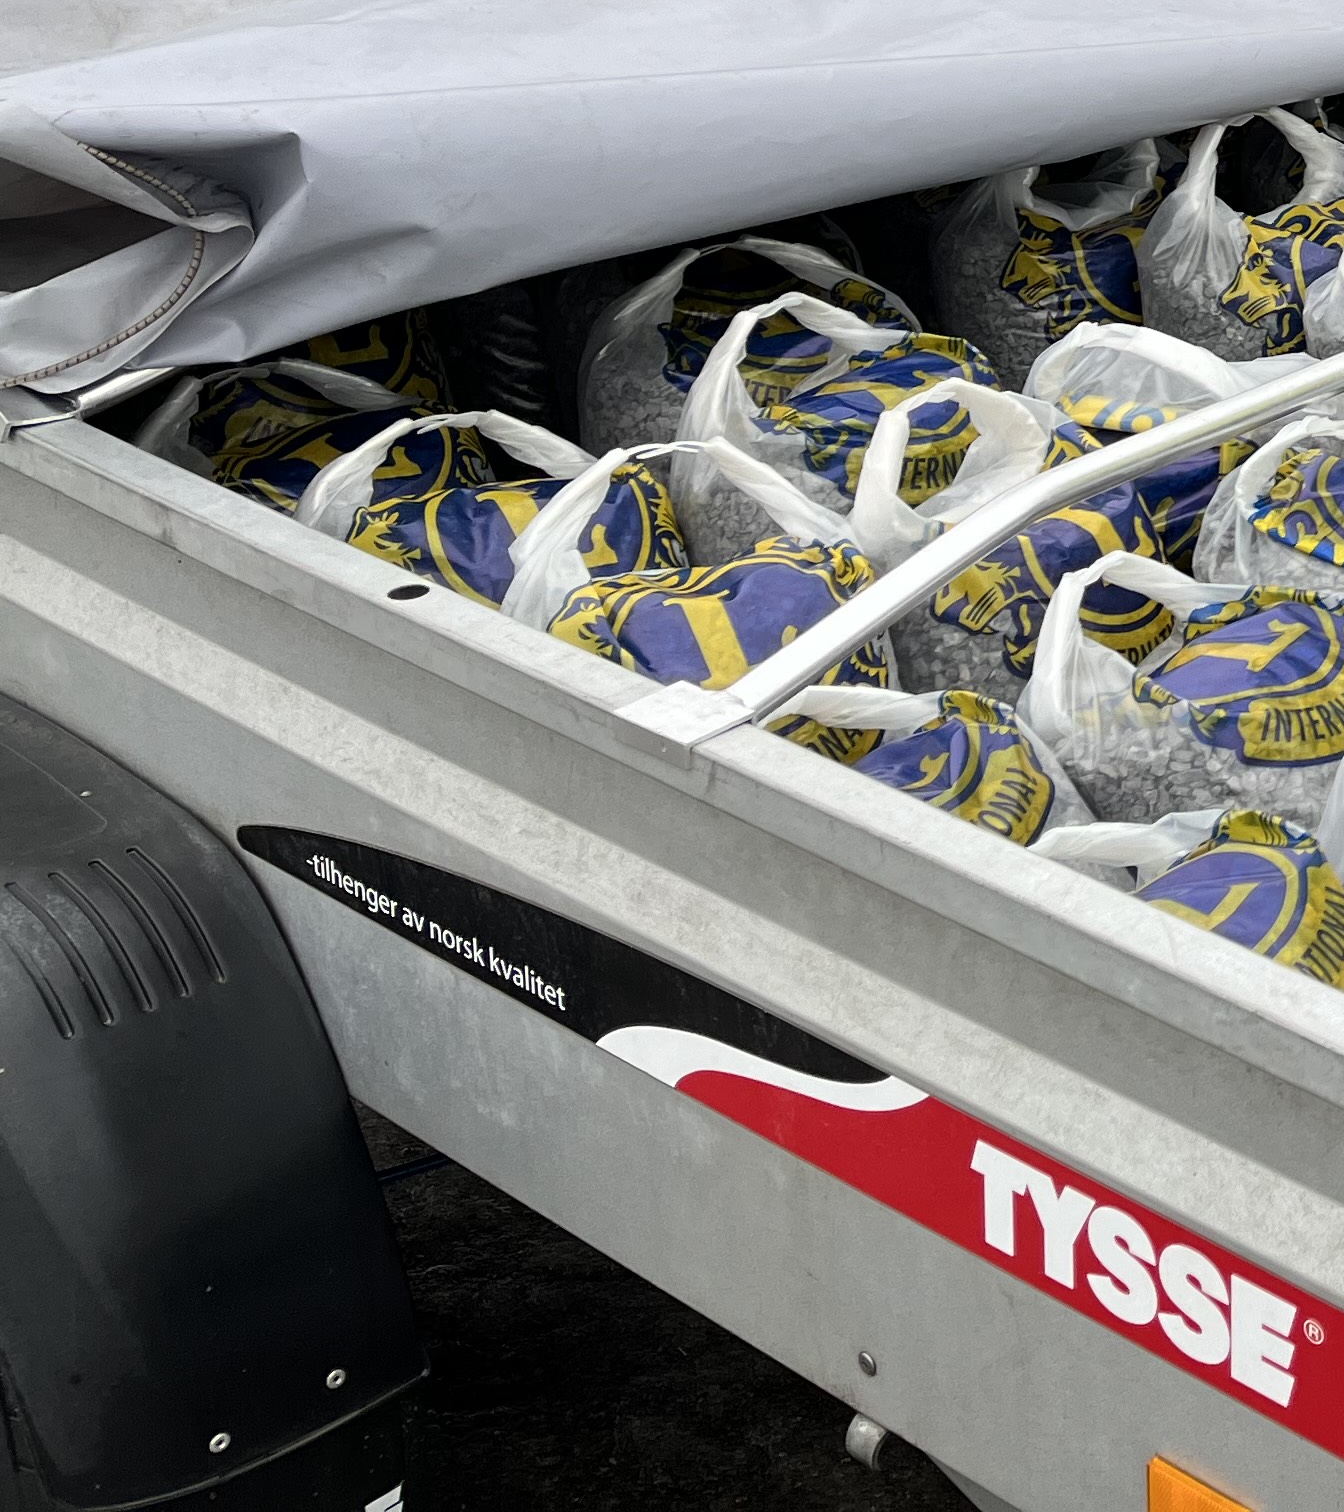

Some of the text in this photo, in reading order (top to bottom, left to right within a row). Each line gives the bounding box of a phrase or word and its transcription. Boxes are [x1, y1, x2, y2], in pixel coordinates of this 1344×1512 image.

[306, 854, 566, 1011] -tilhenger av norsk kvalitet
[970, 1139, 1297, 1408] TYSSE
